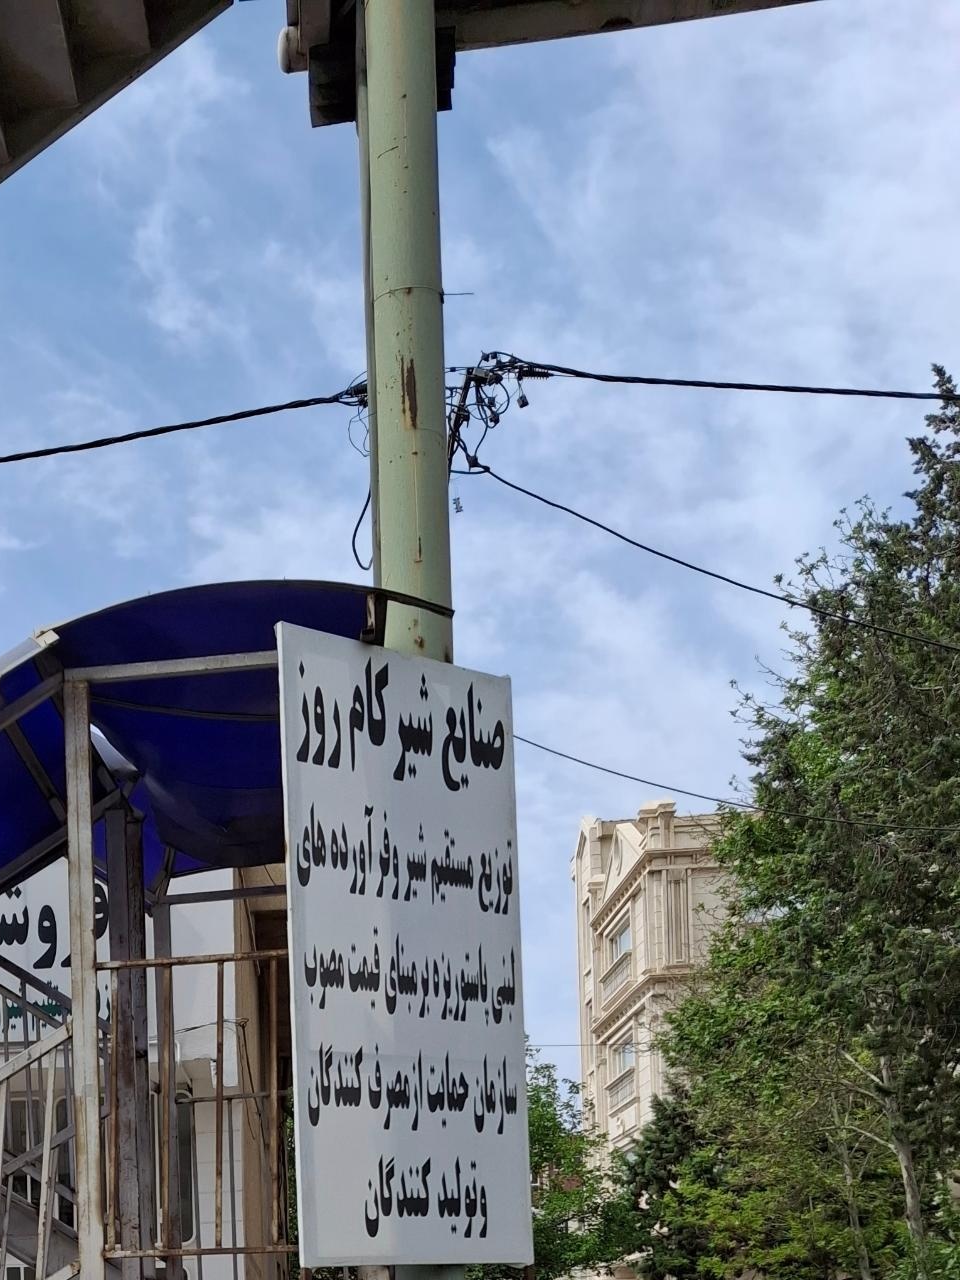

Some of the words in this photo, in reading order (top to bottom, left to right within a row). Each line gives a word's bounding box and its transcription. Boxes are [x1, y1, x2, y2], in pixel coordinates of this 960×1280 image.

[296, 660, 341, 769] روز
[349, 657, 389, 772] کام
[393, 673, 433, 781] شیر
[442, 681, 505, 791] صنایع
[404, 823, 427, 901] شیر
[431, 829, 474, 905] مستقیم
[478, 839, 513, 915] توزیع
[304, 944, 344, 1010] مصوب
[347, 925, 380, 1010] قیمت
[384, 932, 418, 1015] مبنای
[432, 942, 488, 1026] پاستوریزه
[491, 945, 516, 1024] لبنی
[307, 1041, 363, 1126] کنندگان
[426, 1050, 469, 1129] حمایت
[473, 1054, 517, 1135] سازمان
[364, 1153, 431, 1238] کنندگان
